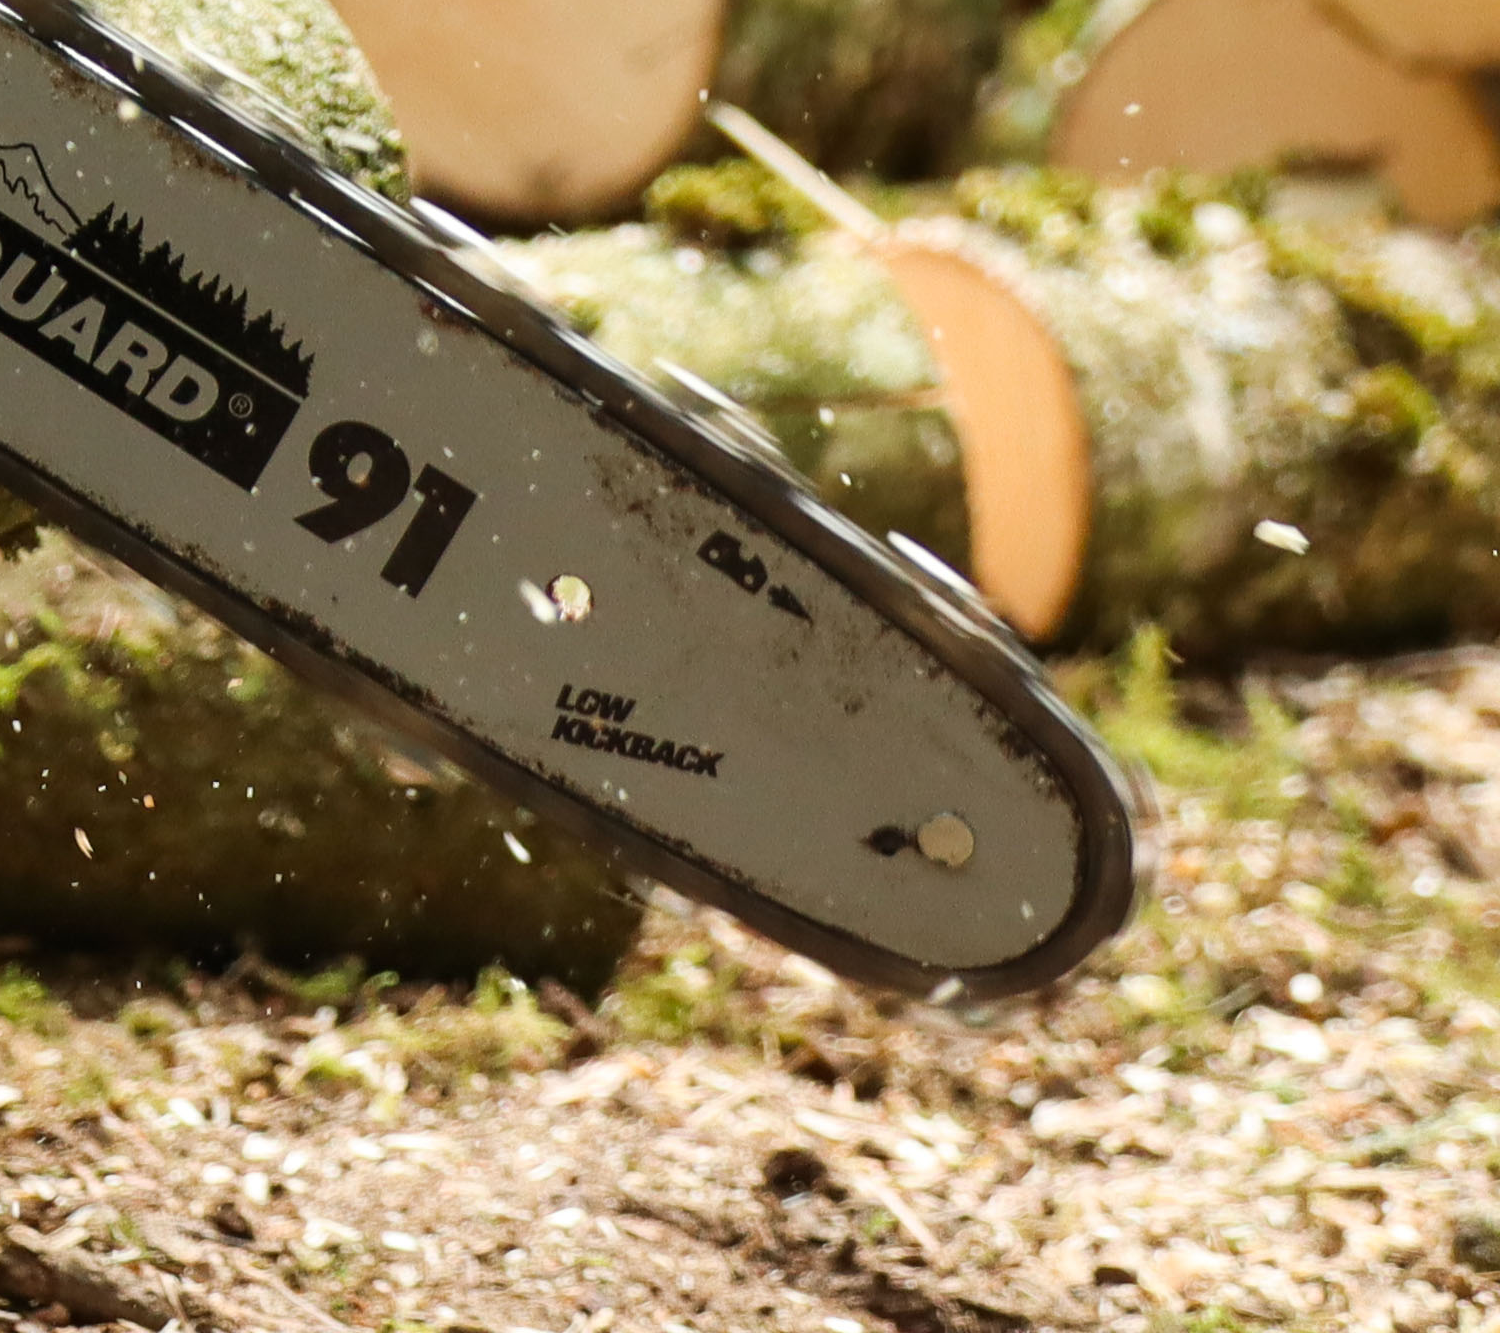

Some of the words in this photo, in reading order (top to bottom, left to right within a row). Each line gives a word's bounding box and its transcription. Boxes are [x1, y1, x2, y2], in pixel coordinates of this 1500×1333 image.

[293, 420, 477, 599] 91
[554, 683, 637, 723] LOW
[550, 714, 725, 778] KICKBACK
